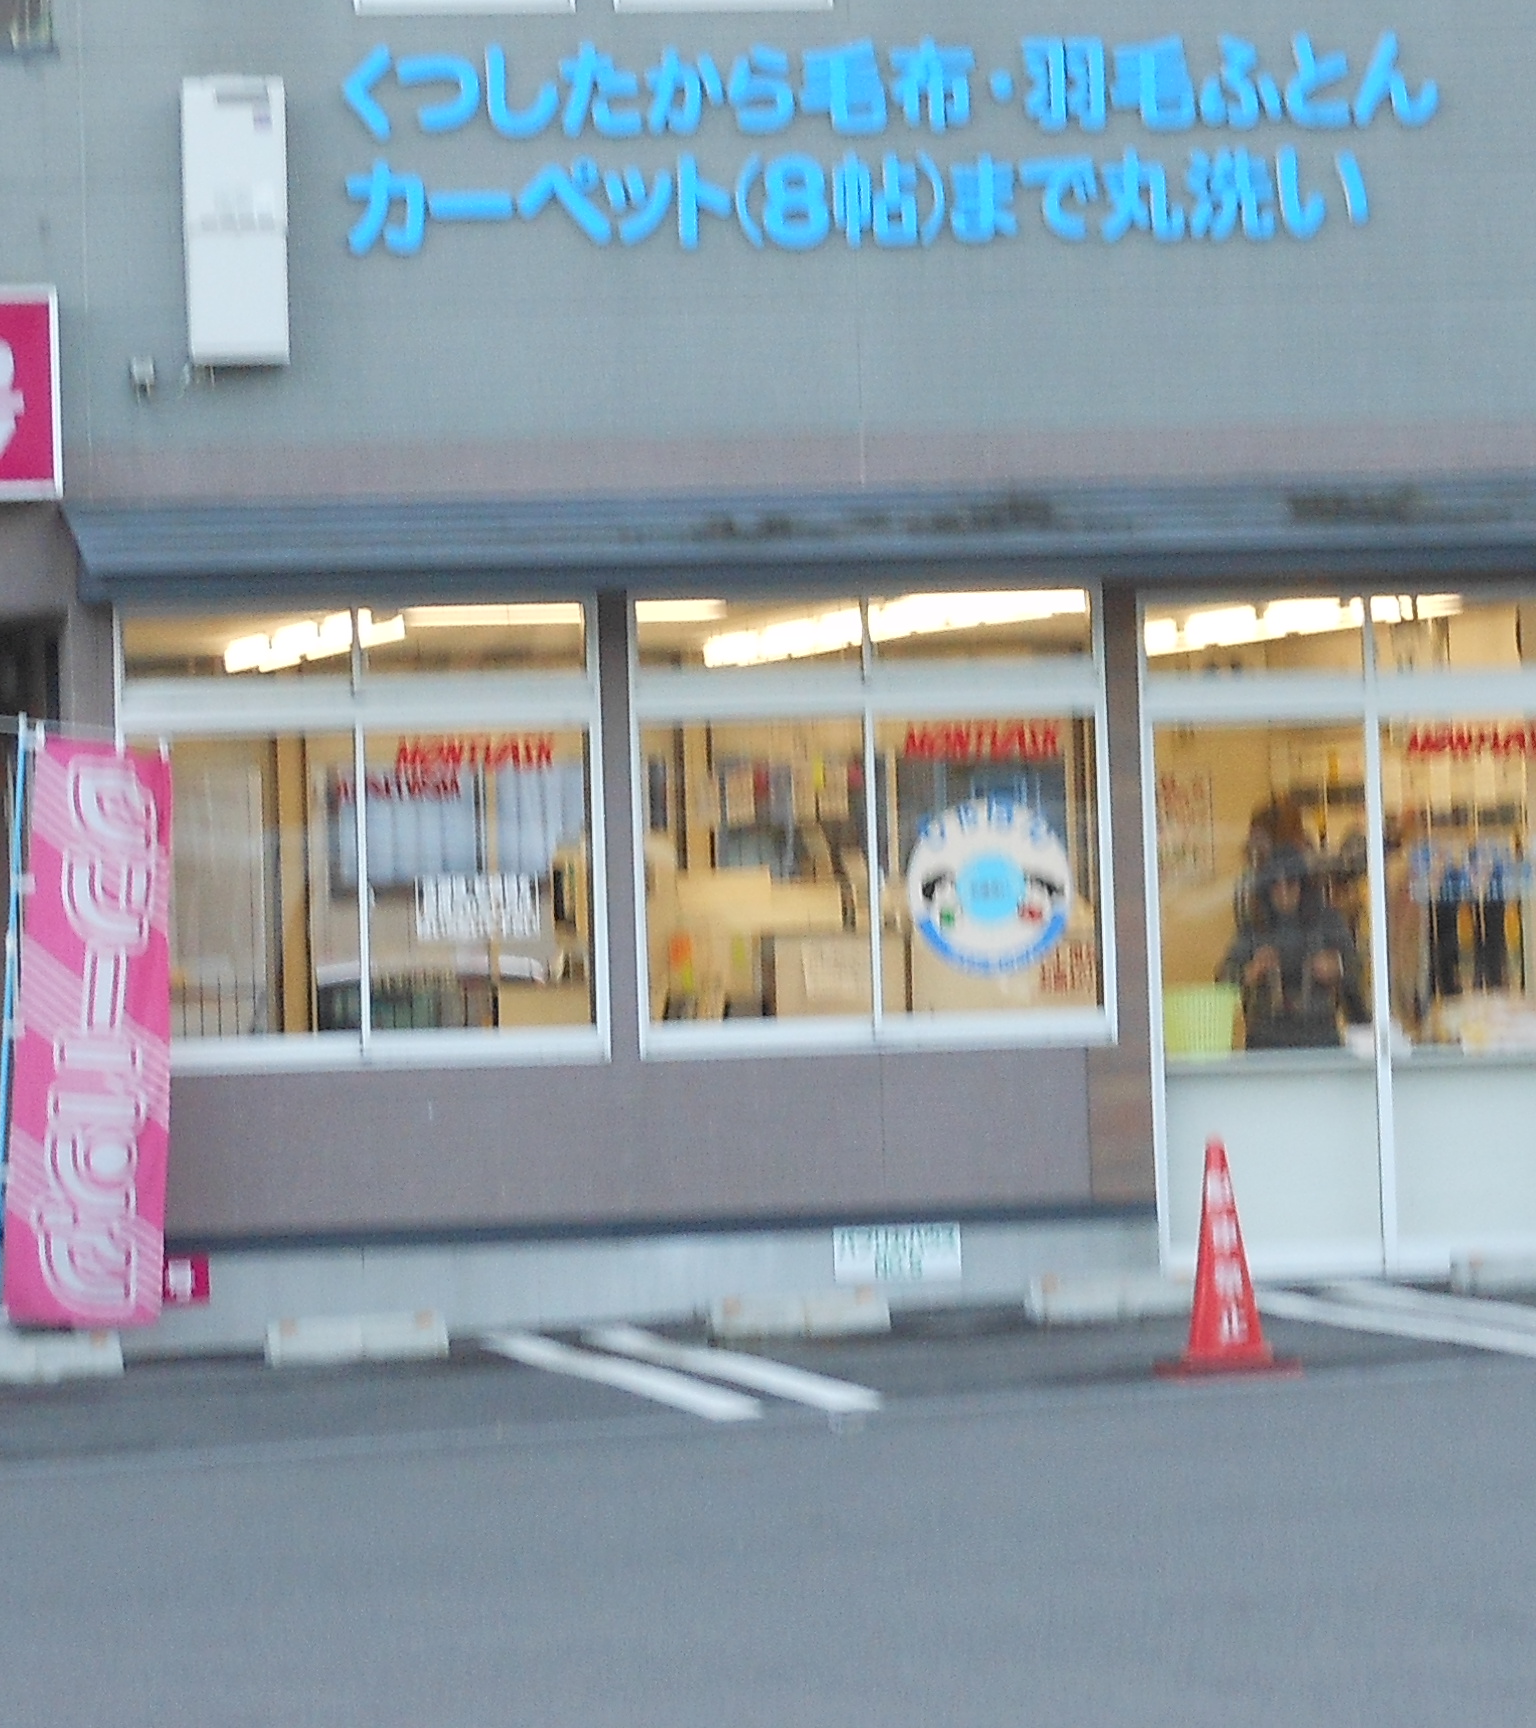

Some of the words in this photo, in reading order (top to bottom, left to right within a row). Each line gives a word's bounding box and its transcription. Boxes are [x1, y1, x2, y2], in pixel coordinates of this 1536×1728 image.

[343, 29, 1439, 141] くつしたから毛布・羽毛ふとん
[345, 144, 1371, 257] カーペット(8帖)まで丸洗い
